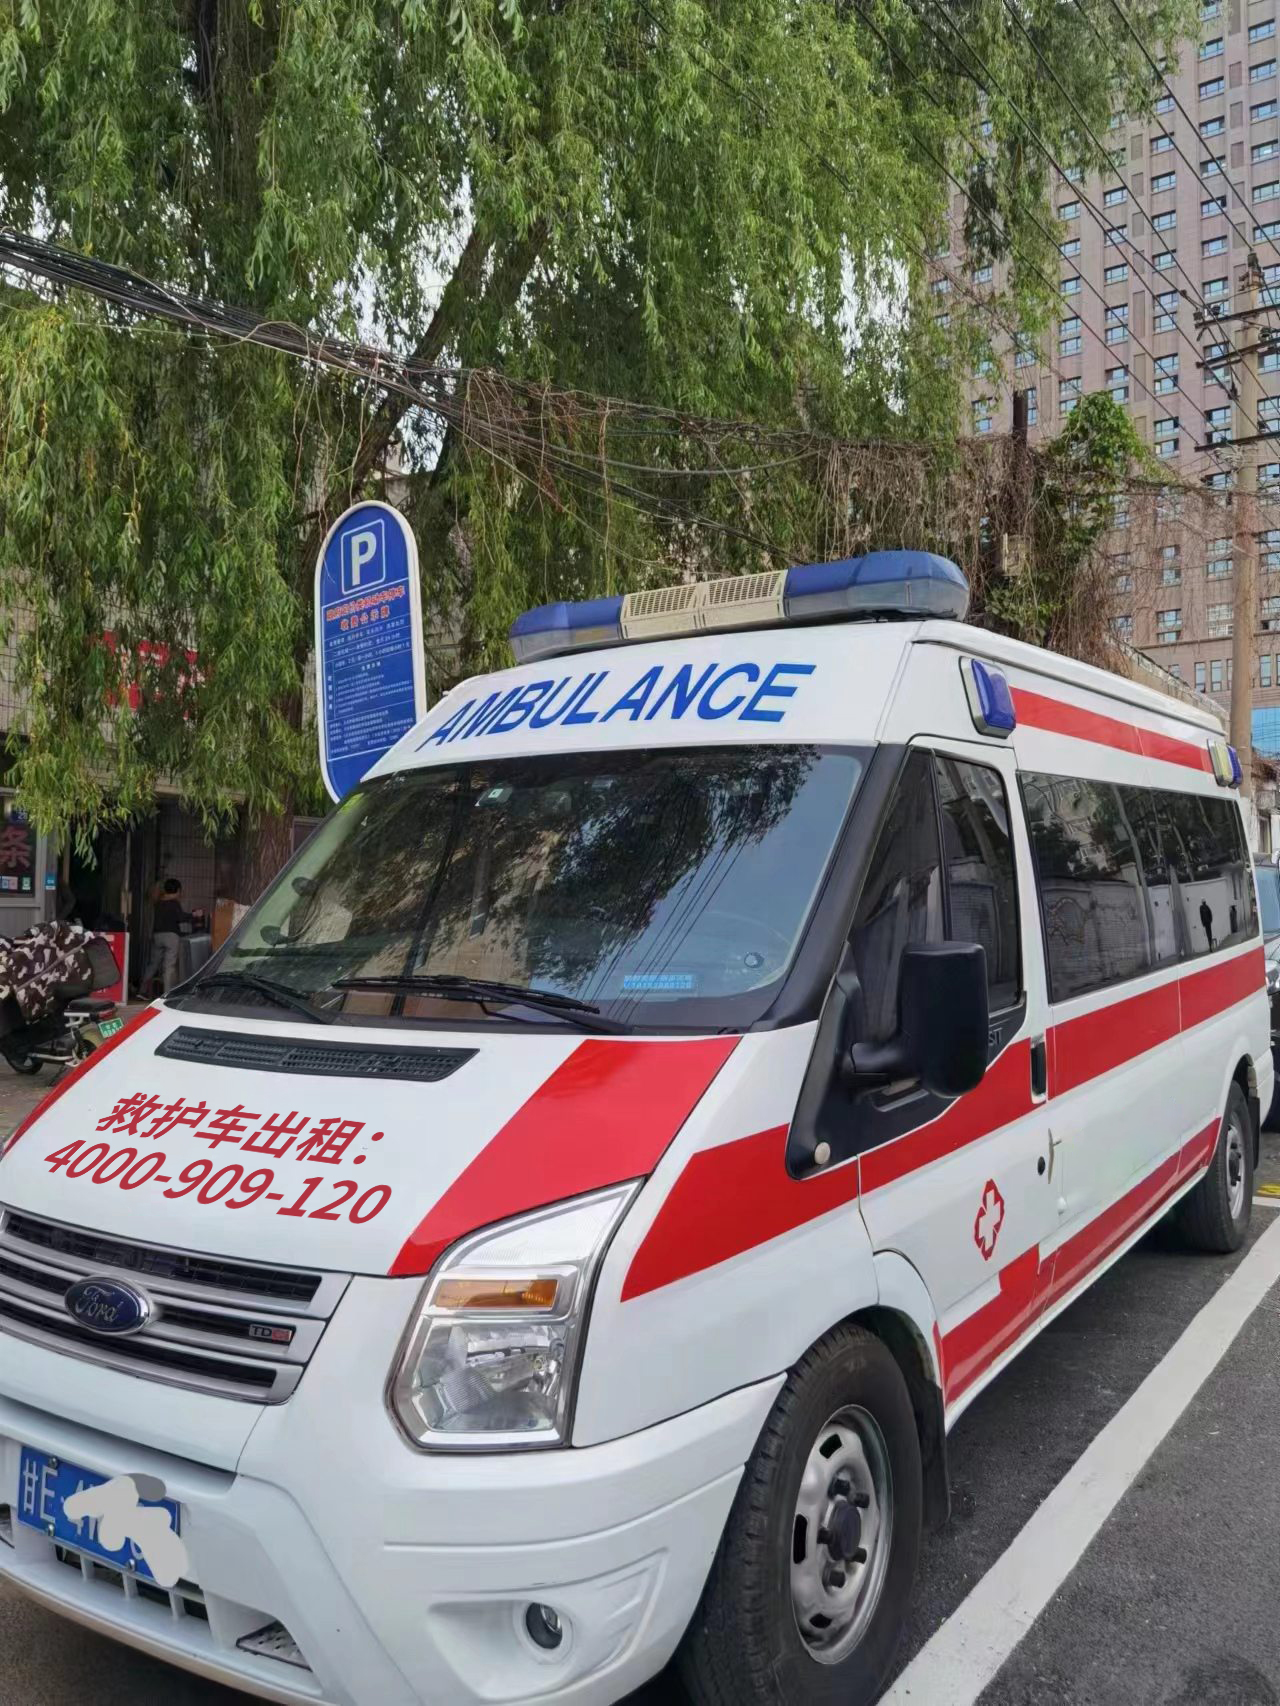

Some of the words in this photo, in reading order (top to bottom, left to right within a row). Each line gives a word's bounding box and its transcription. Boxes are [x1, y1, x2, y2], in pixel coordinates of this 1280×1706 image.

[351, 531, 377, 586] P
[414, 663, 817, 752] AMBULANCE
[44, 1139, 392, 1224] 4000-909-120
[75, 1286, 124, 1322] Ford
